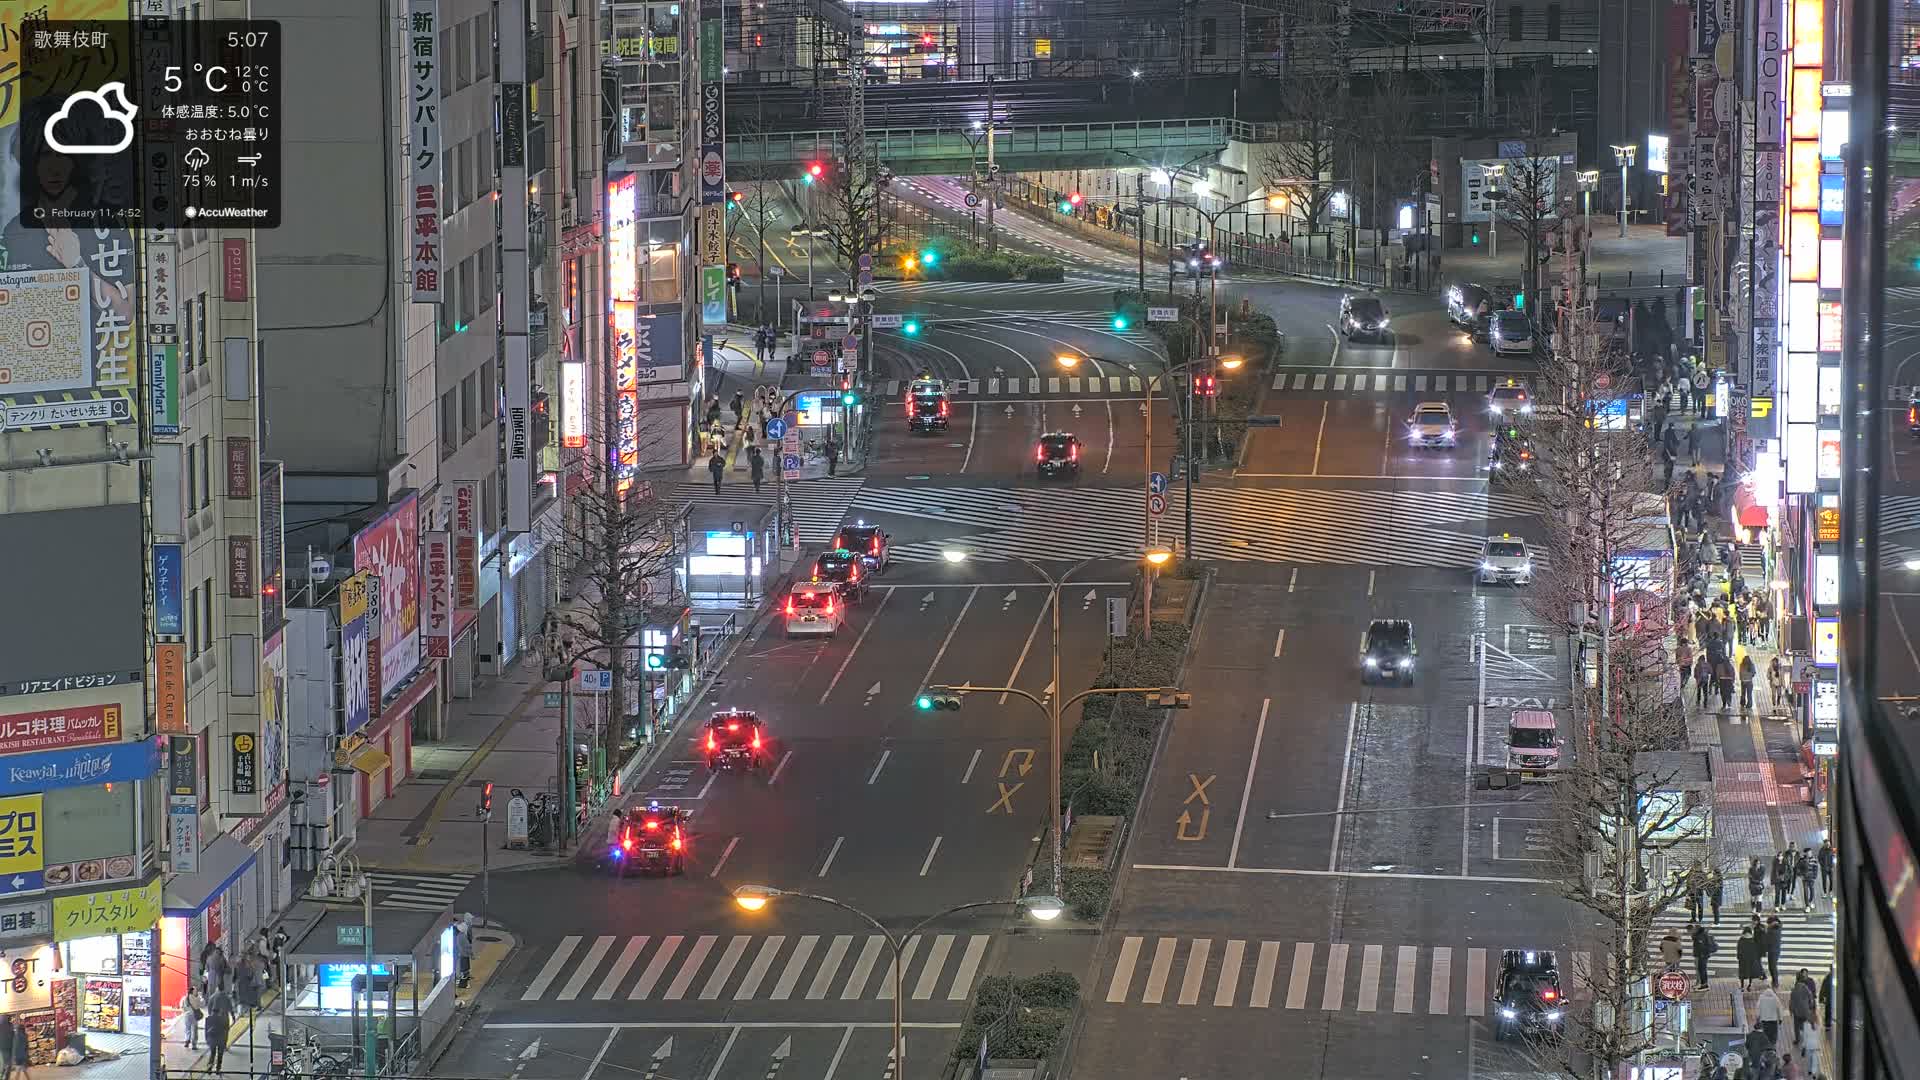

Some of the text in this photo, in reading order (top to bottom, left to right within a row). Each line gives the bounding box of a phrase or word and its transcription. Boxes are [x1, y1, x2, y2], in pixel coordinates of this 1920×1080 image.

[412, 12, 435, 169] 新宿サンパーク
[1703, 88, 1713, 121] アコム
[415, 184, 438, 292] 三平本館
[707, 208, 720, 262] 肉汁水餃子
[706, 276, 720, 313] レイク
[1756, 330, 1769, 382] 大衆酒場
[152, 353, 165, 415] FamilyMart
[10, 404, 108, 422] テンクリ たいせい先生
[510, 407, 525, 460] HOMEGAME
[457, 487, 469, 532] GAME
[157, 555, 169, 606] ゲウチャイ
[429, 542, 446, 629] 三平ストア
[164, 650, 175, 679] CAFE
[22, 735, 65, 747] RESTAURANT
[0, 811, 36, 835] プロ
[176, 817, 184, 856] ゲウチャイ
[1, 911, 36, 931] 囲碁
[67, 904, 139, 927] クリスタル
[1662, 980, 1684, 990] 消火栓
